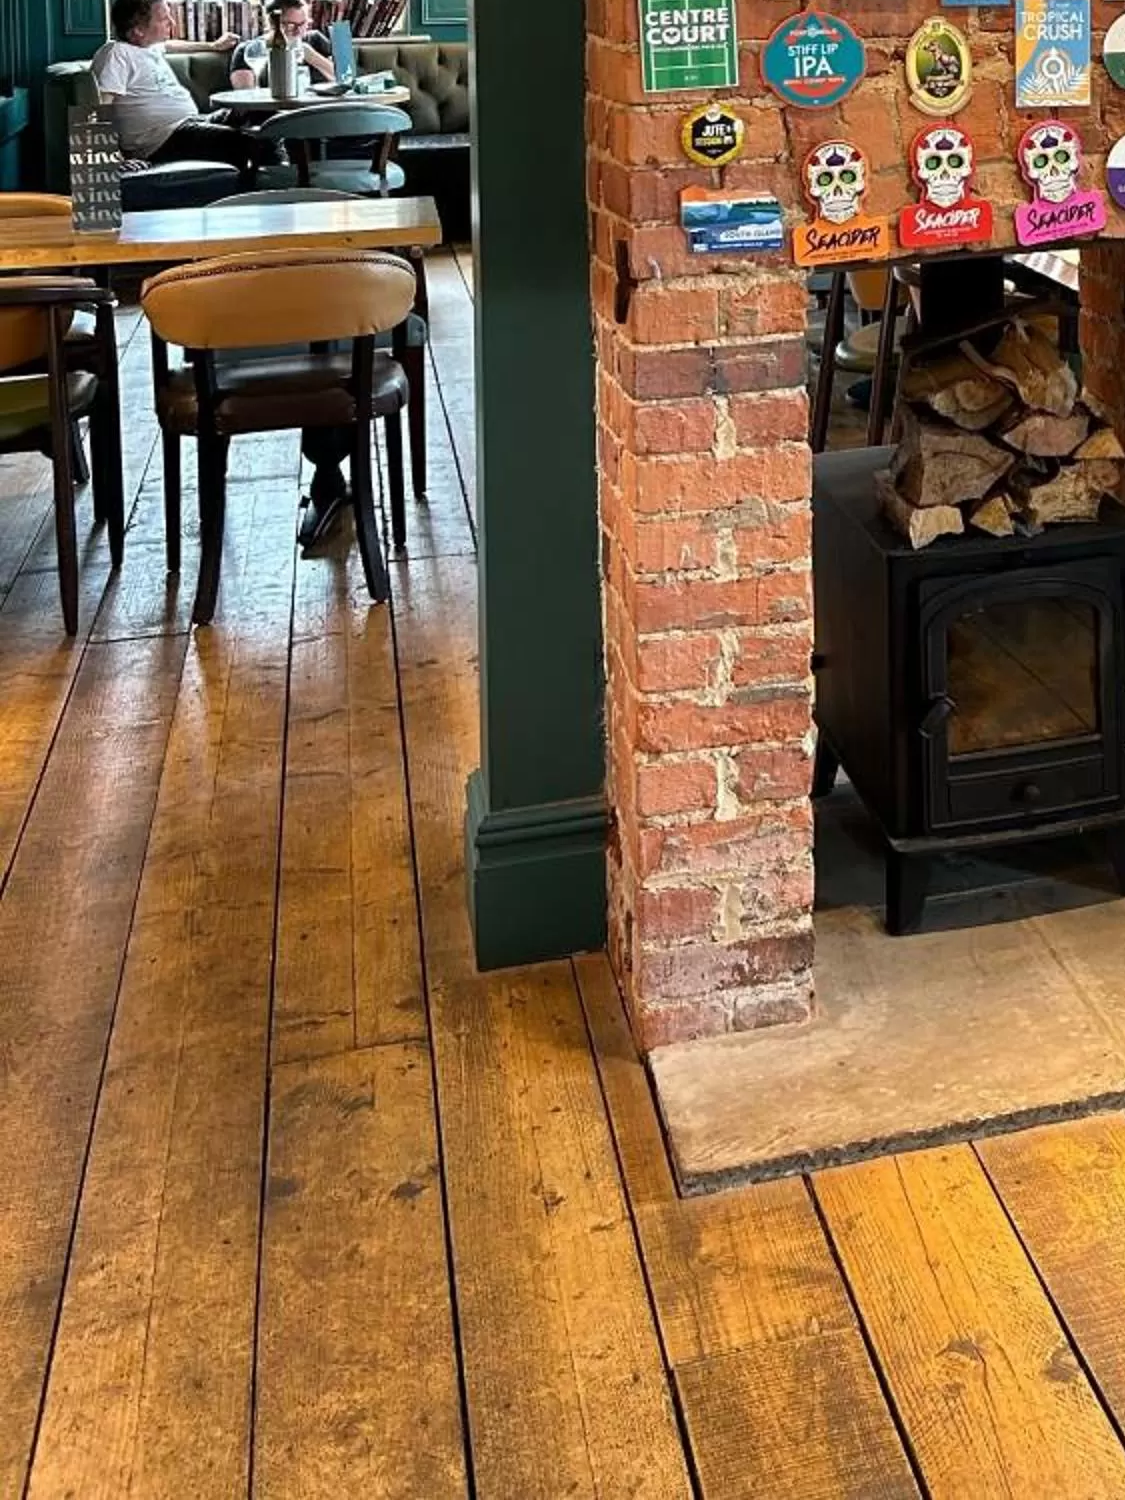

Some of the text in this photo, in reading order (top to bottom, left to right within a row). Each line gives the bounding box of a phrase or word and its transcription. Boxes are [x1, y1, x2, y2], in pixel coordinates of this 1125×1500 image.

[645, 7, 729, 25] CENTRE
[1022, 11, 1085, 24] TROPICAL
[646, 24, 730, 45] COURT
[1023, 24, 1082, 41] CRUSH
[787, 43, 839, 57] STIFF LIP
[794, 56, 834, 77] IPA
[702, 124, 726, 136] JUTE
[912, 207, 981, 234] SEACIDER
[1027, 202, 1096, 236] SEACIDER
[803, 225, 881, 256] SEACIDER
